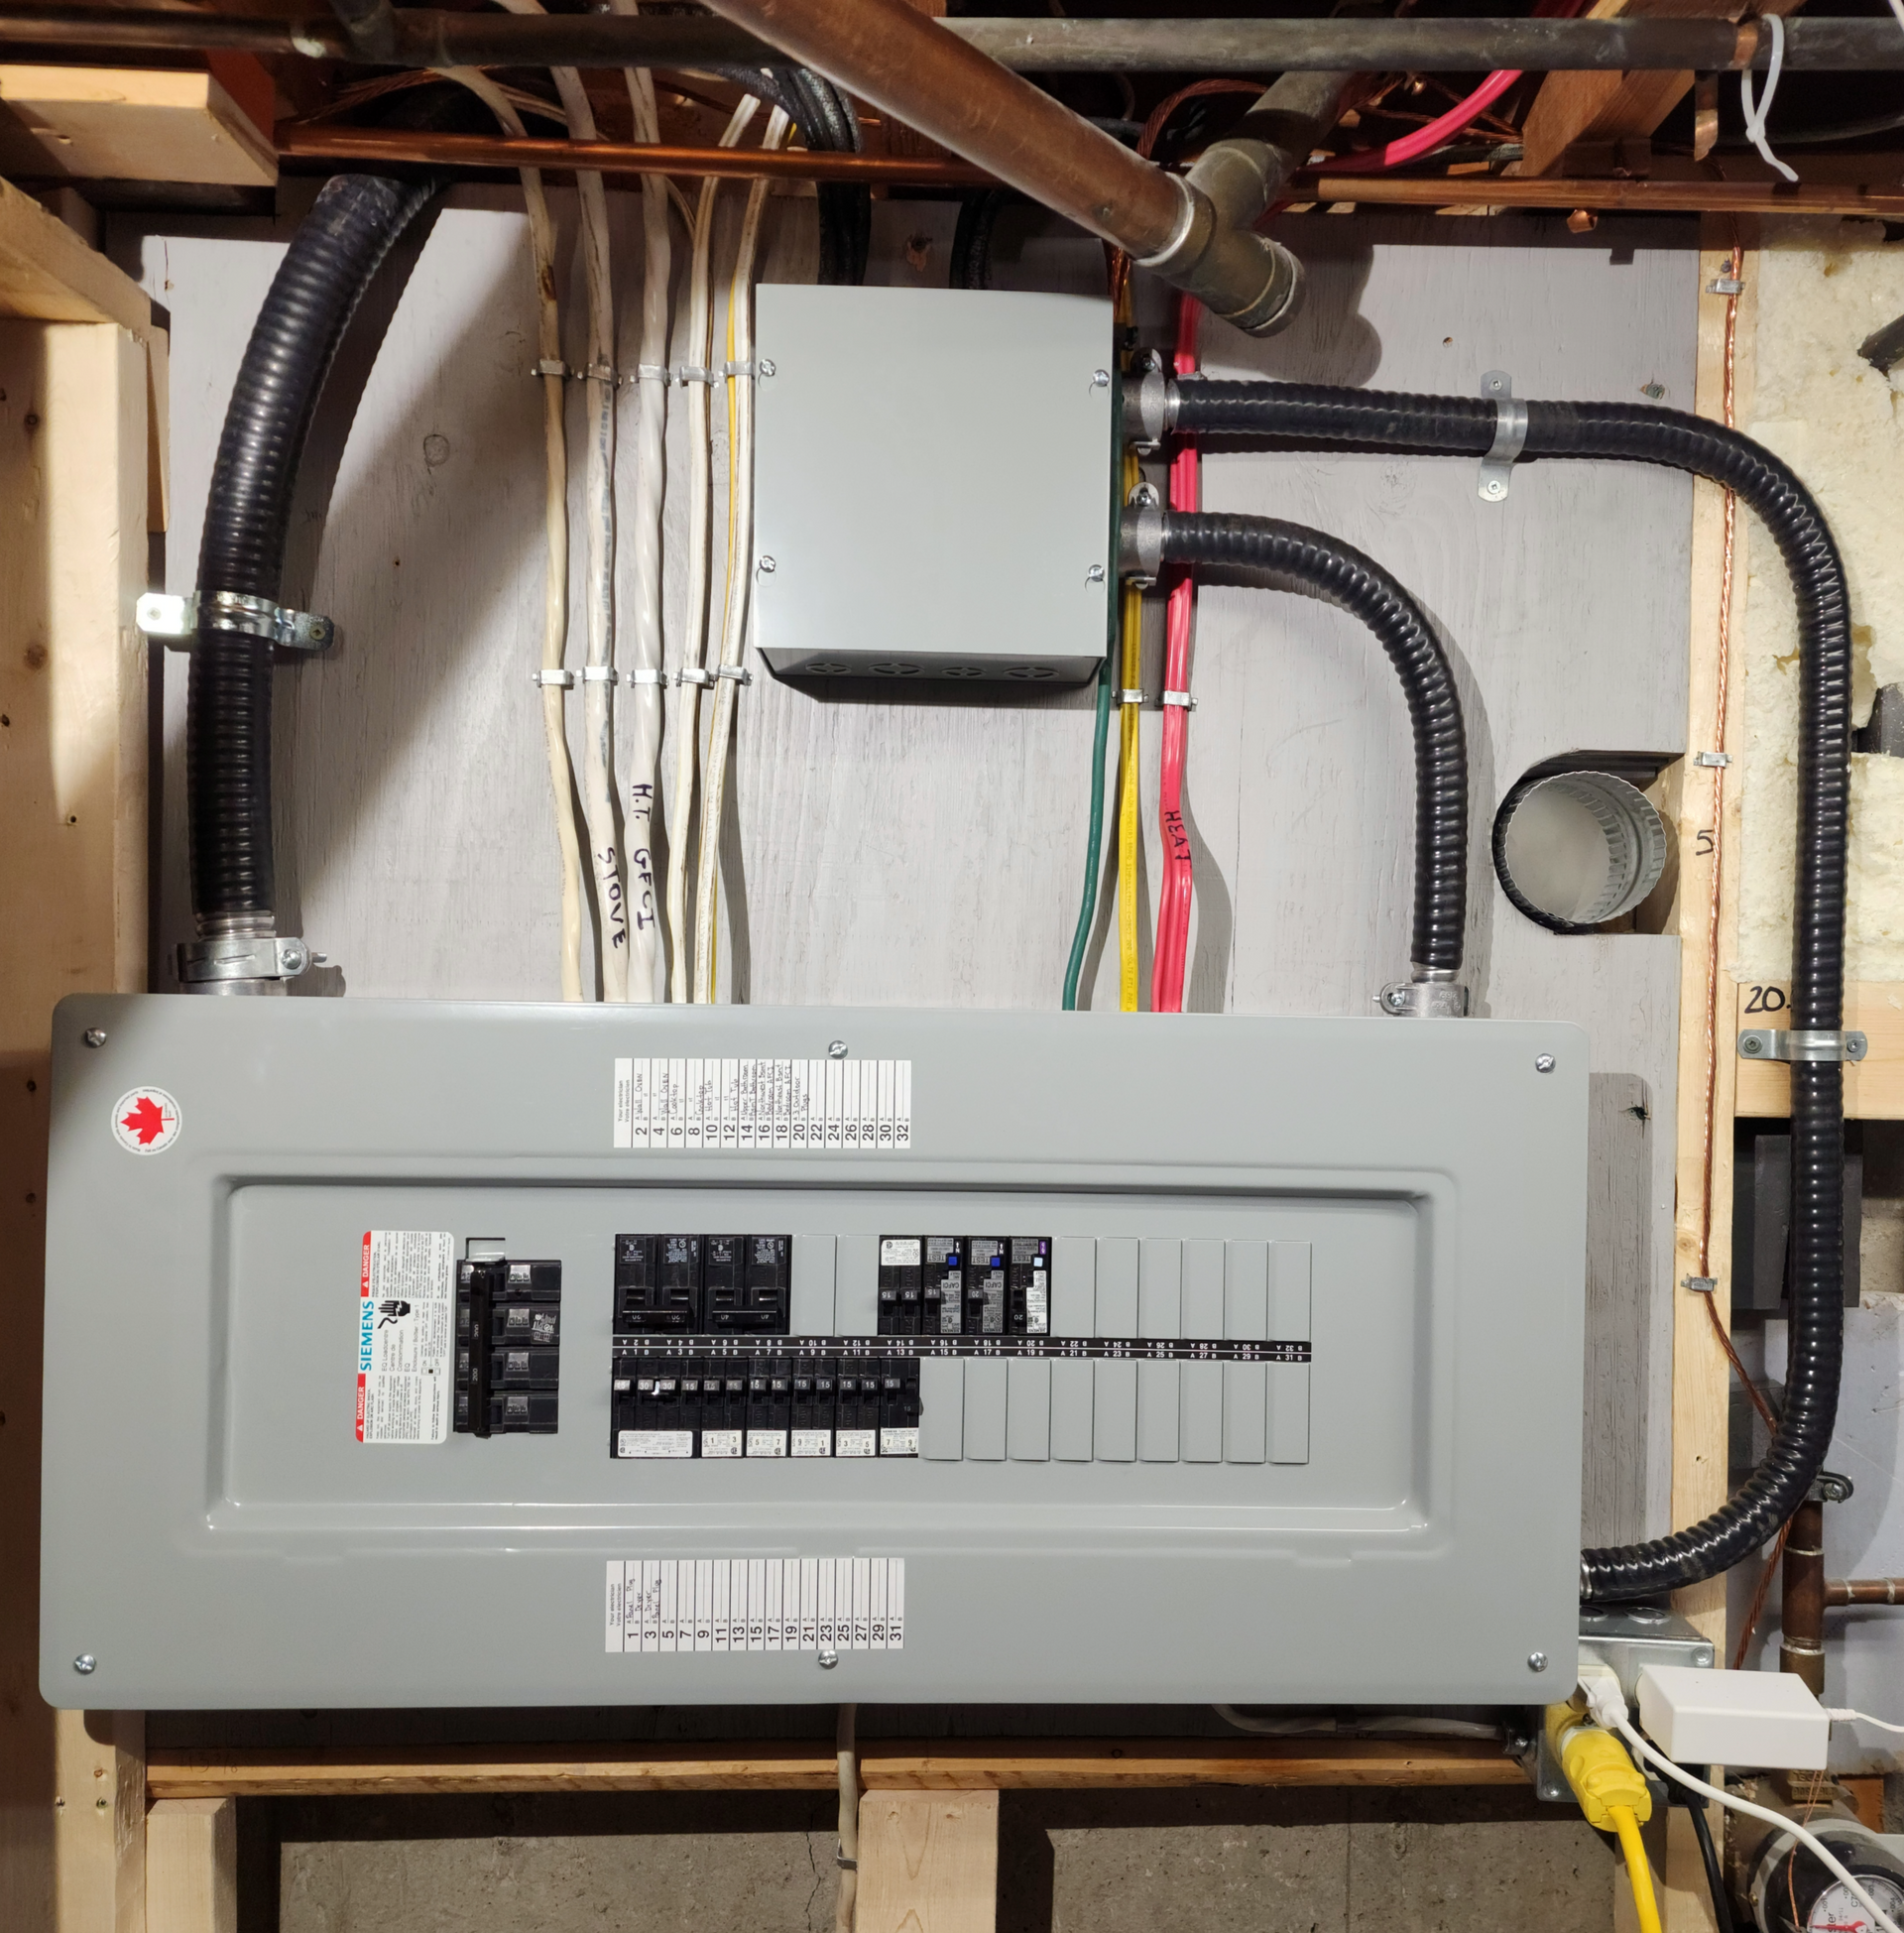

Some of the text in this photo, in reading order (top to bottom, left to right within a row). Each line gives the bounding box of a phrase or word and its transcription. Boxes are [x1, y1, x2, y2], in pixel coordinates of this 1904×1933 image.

[1164, 810, 1192, 868] HEAT
[1696, 830, 1714, 855] 5
[633, 784, 654, 930] H.T. GFCI
[598, 847, 626, 948] STOVE
[668, 1083, 679, 1115] Cooktop
[695, 1085, 704, 1115] Cooktop
[756, 1080, 766, 1116] Northwest
[765, 1086, 774, 1116] Bedroom
[659, 1099, 668, 1115] Wall
[636, 1127, 647, 1136] 2
[670, 1127, 682, 1136] 6
[688, 1127, 700, 1136] 8
[706, 1125, 718, 1141] 10
[723, 1125, 735, 1141] 12
[741, 1125, 753, 1141] 14
[759, 1125, 770, 1141] 16
[775, 1125, 787, 1141] 18
[793, 1124, 805, 1141] 20
[810, 1125, 822, 1141] 22
[828, 1125, 839, 1141] 24
[845, 1125, 857, 1141] 26
[863, 1125, 874, 1141] 28
[880, 1125, 892, 1142] 30
[896, 1125, 908, 1142] 32
[360, 1301, 375, 1372] SIEMENS
[381, 1362, 388, 1372] EQ
[405, 1363, 411, 1372] EQ
[626, 1579, 635, 1592] Plug
[653, 1579, 661, 1593] Plug
[645, 1631, 656, 1639] 3
[697, 1630, 709, 1638] 9
[715, 1629, 727, 1643] 11
[733, 1627, 745, 1642] 13
[750, 1627, 762, 1642] 15
[768, 1626, 779, 1642] 17
[785, 1626, 797, 1642] 19
[802, 1627, 814, 1641] 21
[820, 1625, 832, 1641] 23
[837, 1625, 849, 1641] 25
[855, 1625, 867, 1641] 27
[873, 1625, 885, 1641] 29
[890, 1626, 901, 1641] 31
